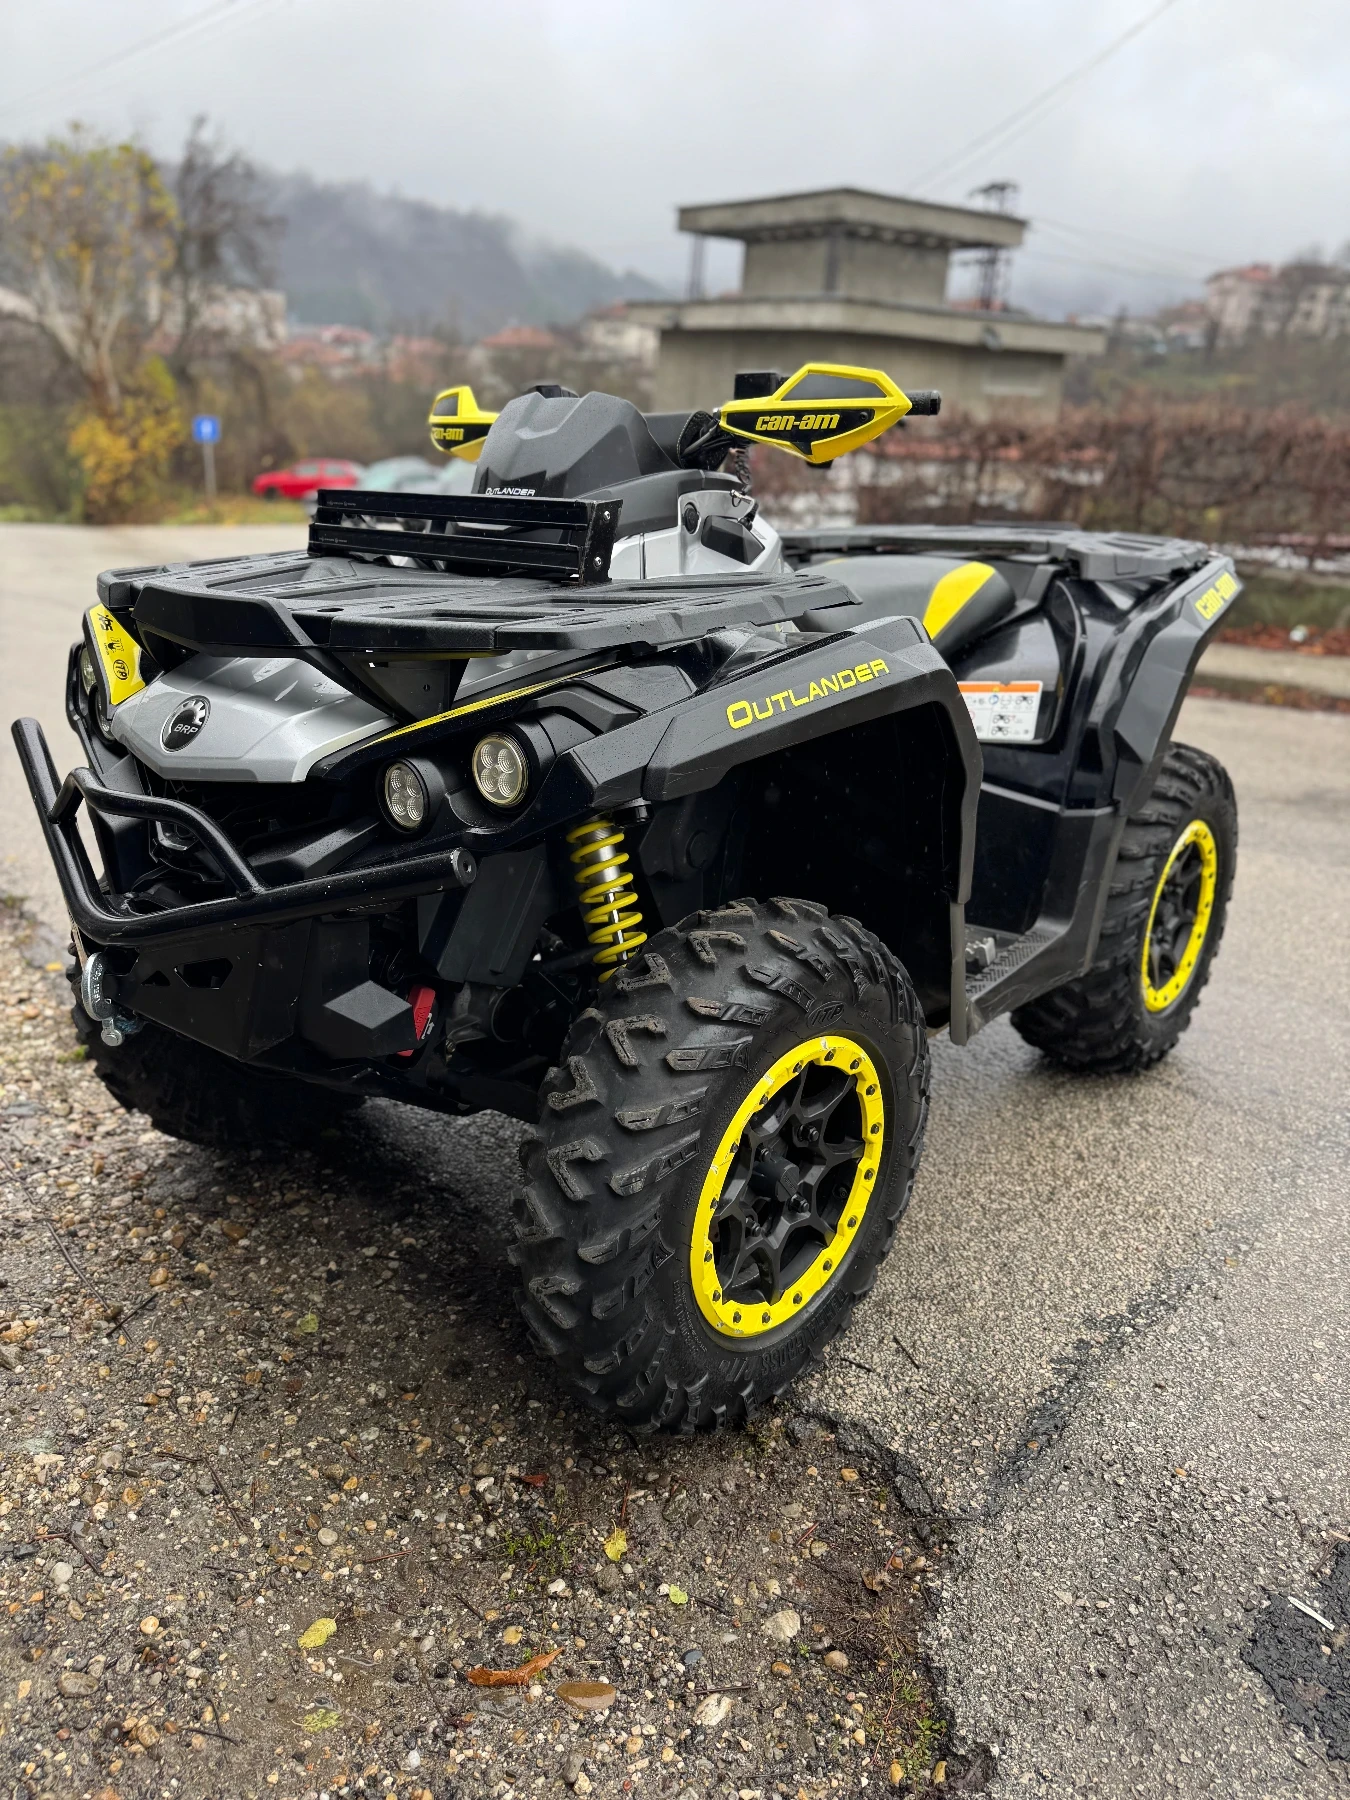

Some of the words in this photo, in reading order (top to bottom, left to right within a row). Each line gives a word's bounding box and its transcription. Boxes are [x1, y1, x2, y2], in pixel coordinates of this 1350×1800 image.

[755, 414, 840, 431] can-am
[485, 487, 536, 497] OUTLANDER
[1195, 572, 1239, 621] can-am
[114, 660, 128, 680] ITP
[726, 658, 890, 730] OUTLANDER
[173, 723, 199, 735] BRP
[811, 1002, 845, 1028] ITP
